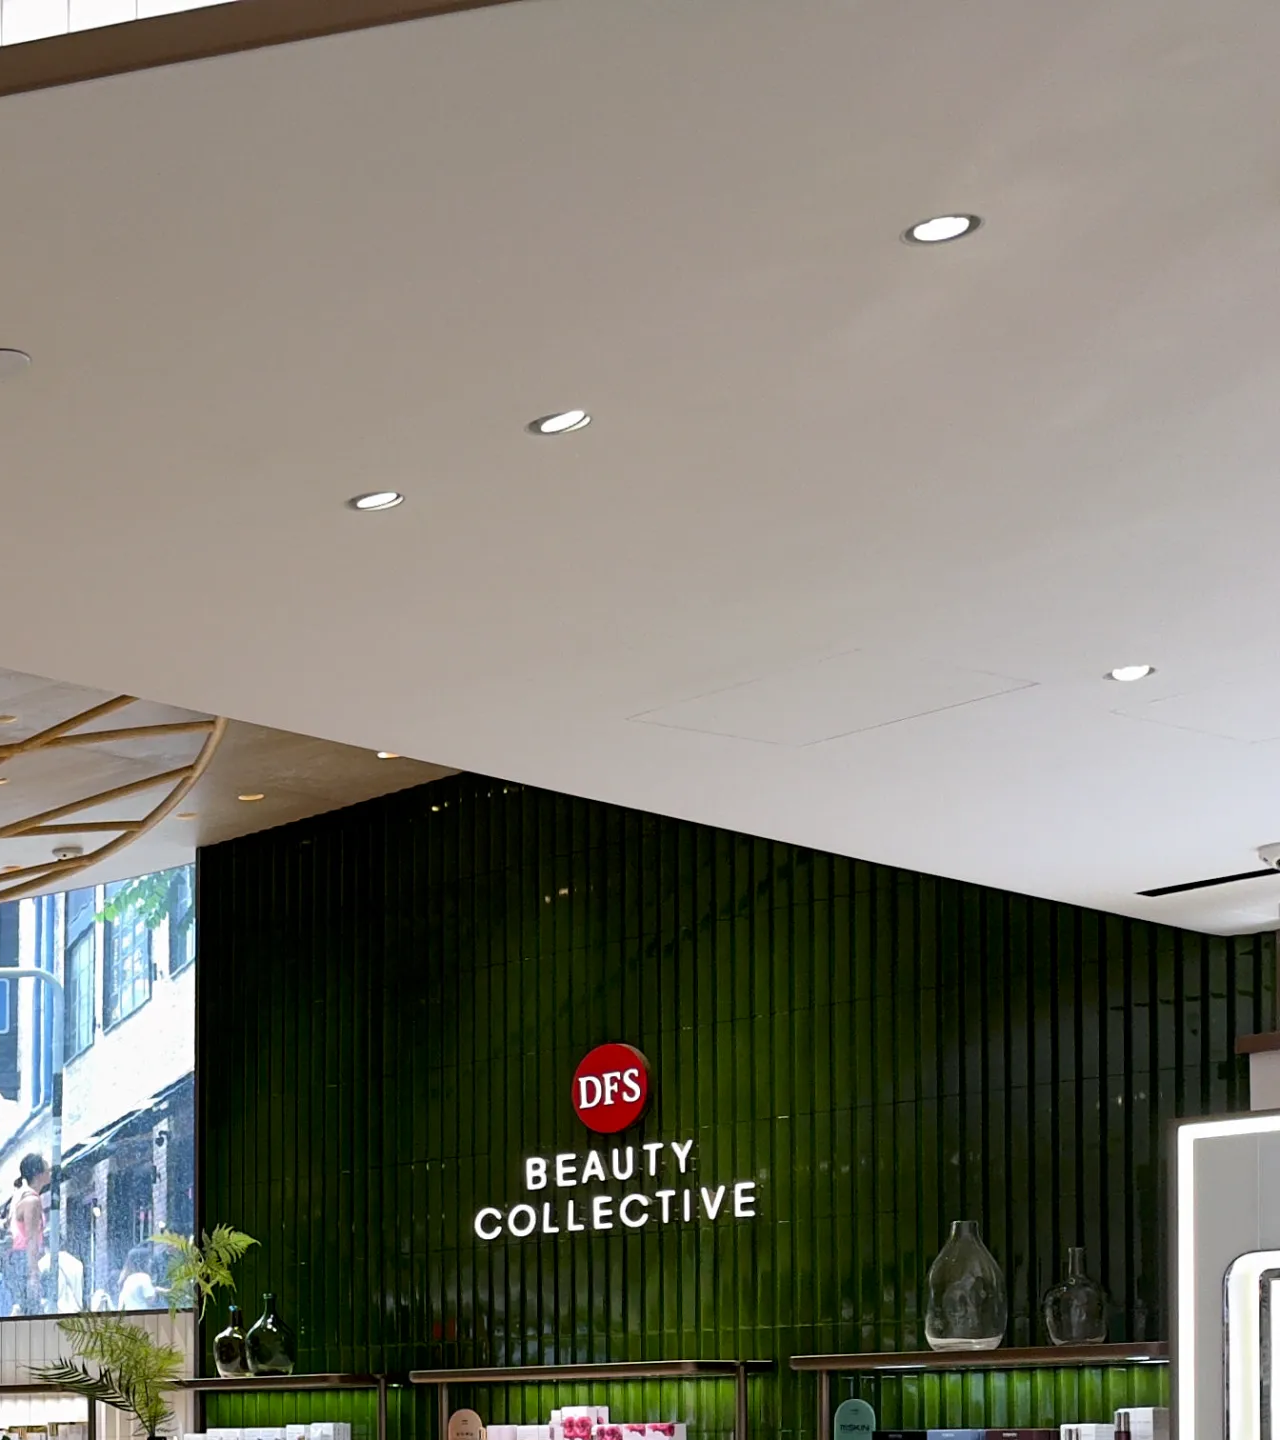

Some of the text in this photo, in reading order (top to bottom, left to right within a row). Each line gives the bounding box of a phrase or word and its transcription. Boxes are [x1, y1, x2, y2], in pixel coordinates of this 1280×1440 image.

[578, 1067, 642, 1110] DFS
[526, 1139, 694, 1191] BEAUTY
[474, 1181, 757, 1240] COLLECTIVE
